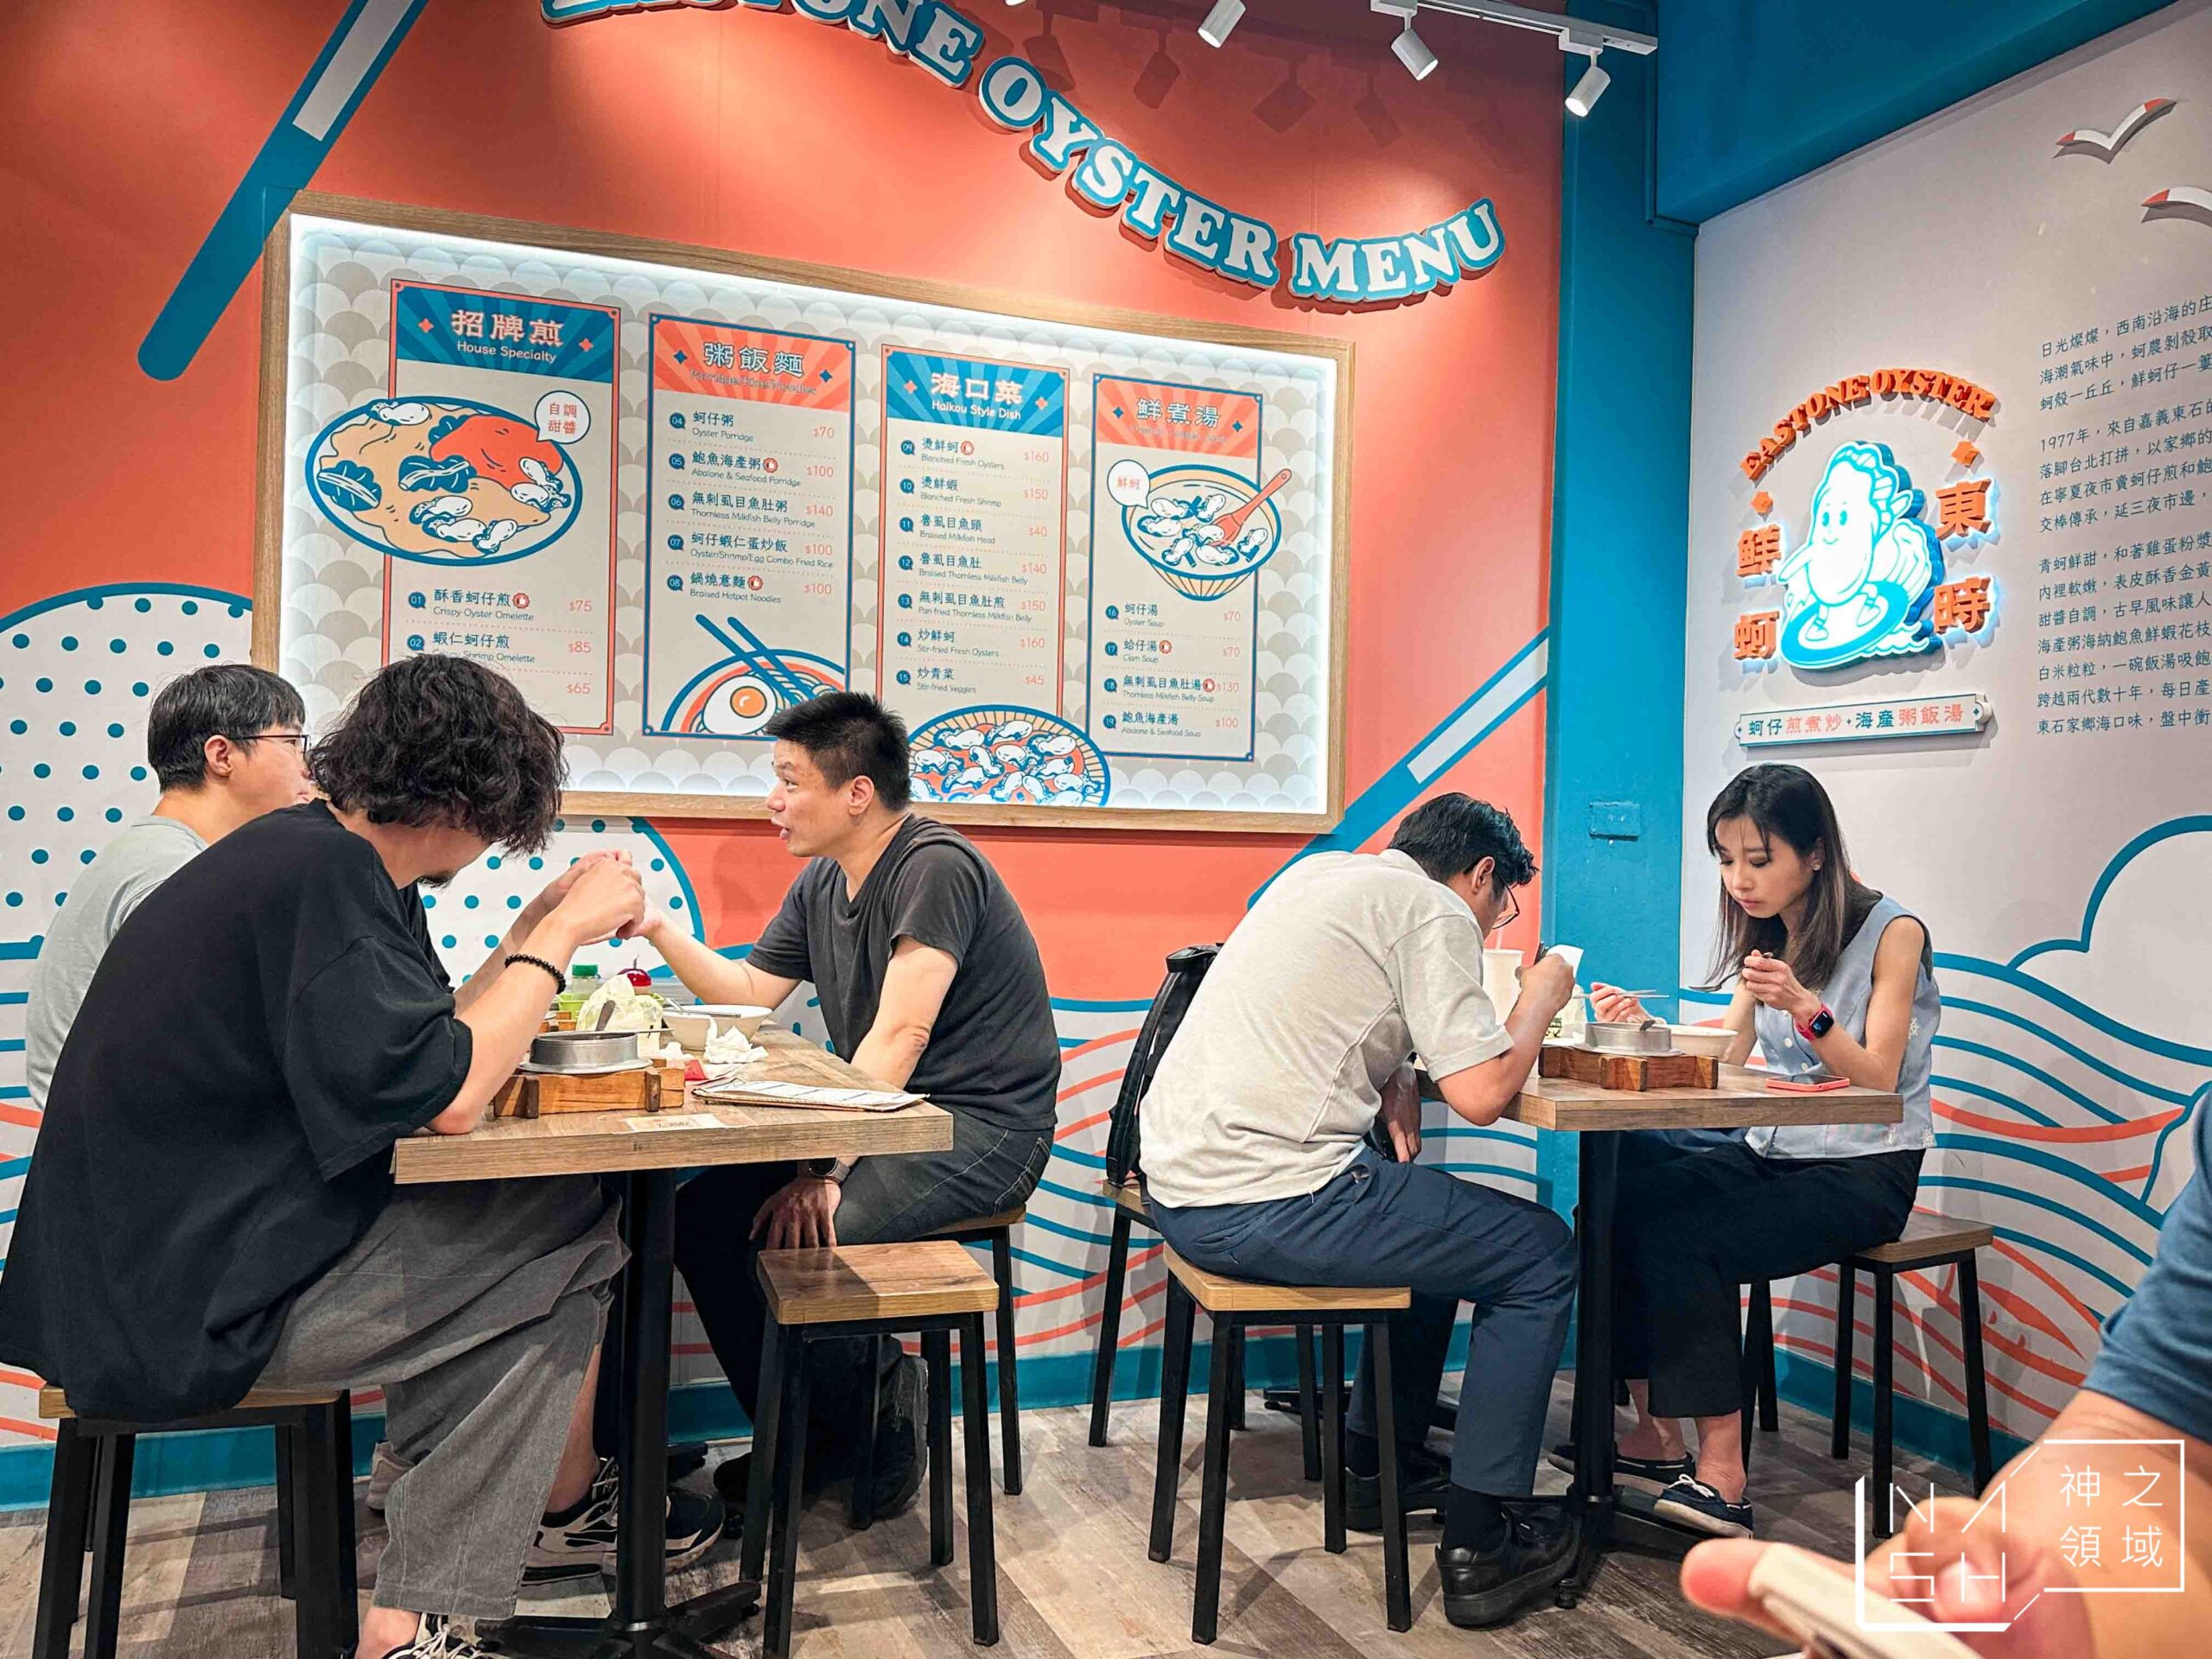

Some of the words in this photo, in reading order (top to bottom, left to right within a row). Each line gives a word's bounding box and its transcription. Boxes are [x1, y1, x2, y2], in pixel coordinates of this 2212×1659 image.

[984, 61, 1277, 280] OYSTER
[1296, 202, 1503, 293] MENU
[451, 309, 563, 346] 招牌煎
[457, 340, 496, 355] House
[500, 345, 556, 364] Specialty
[704, 342, 804, 378] 粥飯麵
[931, 372, 1023, 405] 海口菜
[1870, 369, 1996, 420] OYSTER
[550, 402, 577, 417] 自調
[932, 401, 967, 414] Haikou
[970, 405, 995, 417] Style
[999, 409, 1021, 420] Dish
[1137, 397, 1221, 429] 鮮煮湯
[693, 411, 734, 427] 蚵仔粥
[692, 428, 718, 438] Oyster
[721, 431, 753, 442] Porridge
[814, 427, 834, 438] $70
[692, 450, 761, 470] 鮑魚海產粥
[922, 454, 954, 465] Blanched
[956, 457, 976, 466] Fresh
[978, 460, 1004, 470] Oysters
[1024, 451, 1049, 462] $160
[692, 468, 724, 478] Abalone
[735, 473, 766, 482] Seafood
[769, 476, 800, 487] Porridge
[807, 467, 834, 477] $100
[921, 493, 953, 502] Blanched
[977, 498, 1002, 507] Shrimp
[1023, 488, 1048, 499] $150
[692, 492, 788, 512] 無刺虱目魚肚粥
[805, 505, 833, 517] $140
[692, 509, 729, 519] Thornless
[732, 512, 761, 522] Milkfish
[763, 515, 782, 525] Belly
[784, 518, 815, 528] Porridge
[919, 531, 947, 540] Braised
[949, 534, 975, 543] Milkfish
[977, 536, 995, 544] Head
[1028, 526, 1047, 537] $40
[691, 532, 788, 552] 蚵仔蝦仁蛋炒飯
[805, 544, 832, 556] $100
[1934, 479, 1992, 633] 東時
[766, 556, 793, 564] Combo
[817, 560, 833, 569] Rice
[1022, 564, 1046, 575] $140
[690, 572, 746, 588] 鍋燒意麵
[919, 569, 946, 578] Braised
[949, 571, 982, 581] Thornless
[983, 575, 1010, 583] Milkfish
[1012, 576, 1028, 585] Belly
[804, 583, 831, 594] $100
[411, 596, 422, 605] 01
[434, 588, 511, 607] 酥香蚵仔煎
[690, 589, 720, 599] Braised
[722, 593, 748, 601] Hotpot
[751, 594, 781, 603] Noodles
[919, 591, 1005, 609] 無刺虱目魚肚煎
[569, 600, 593, 612] $75
[1020, 600, 1046, 611] $150
[1125, 602, 1158, 615] 蚵仔湯
[434, 607, 461, 618] Crispy
[464, 608, 493, 619] Oyster
[495, 611, 534, 620] Omelette
[953, 609, 986, 619] Thornless
[1016, 614, 1032, 623] Belly
[1224, 612, 1241, 622] $70
[1124, 618, 1146, 626] Oyster
[433, 632, 510, 649] 蝦仁蚵仔煎
[918, 628, 955, 643] 炒鮮蚵
[410, 639, 422, 647] 02
[568, 641, 591, 653] $85
[1020, 638, 1045, 648] $160
[497, 652, 536, 663] Omelette
[972, 648, 999, 657] Oysters
[1223, 647, 1240, 658] $70
[917, 666, 954, 680] 炒青菜
[1025, 675, 1044, 685] $45
[567, 683, 591, 694] $65
[950, 685, 976, 694] Veggies
[1217, 683, 1238, 692] $130
[1123, 690, 1154, 699] Thornless
[1216, 718, 1238, 728] $100
[1748, 714, 1842, 737] 蚵仔煎煮炒
[1855, 703, 1963, 729] 海產粥飯湯
